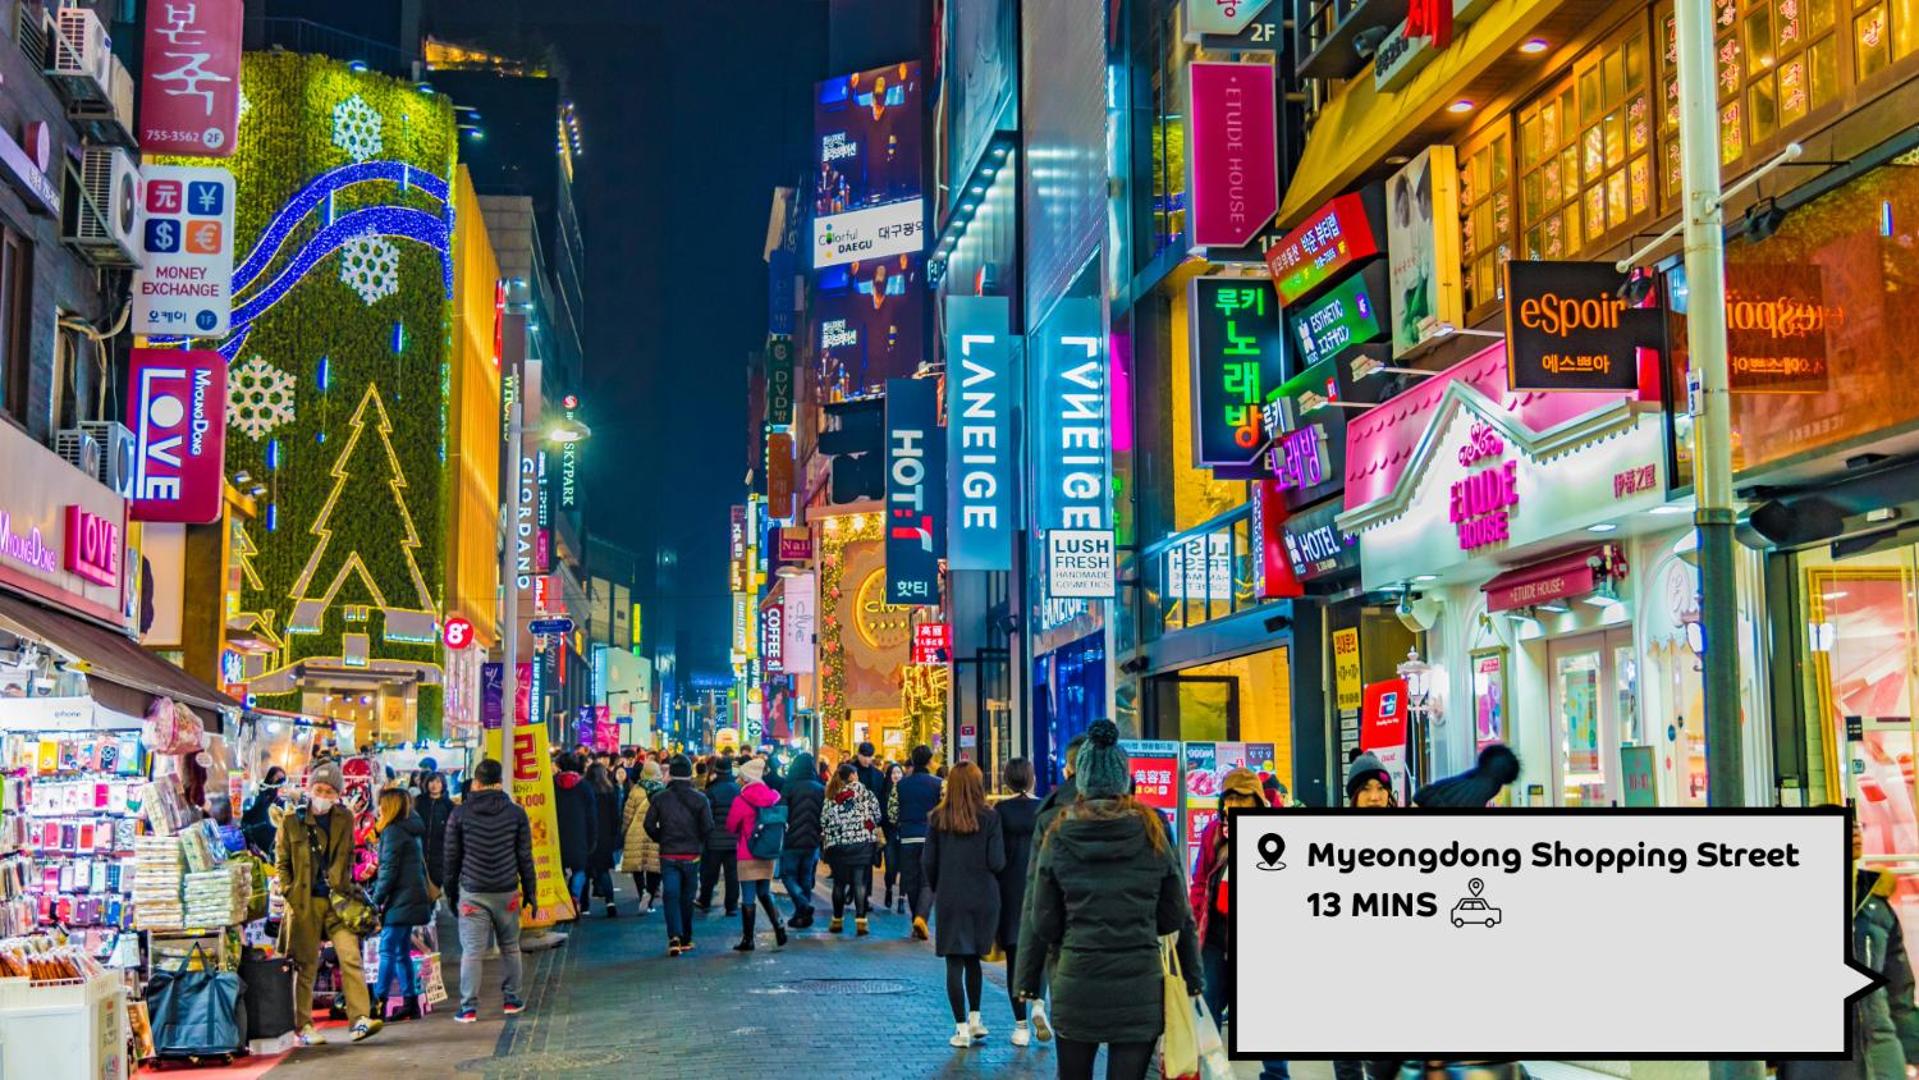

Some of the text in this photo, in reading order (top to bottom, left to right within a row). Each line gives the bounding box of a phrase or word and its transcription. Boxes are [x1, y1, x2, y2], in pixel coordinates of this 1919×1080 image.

[1250, 23, 1276, 42] 2F
[153, 2, 231, 116] 본죽
[146, 128, 221, 146] 755-3562 2F
[1226, 88, 1245, 224] ETUDE HOUSE
[838, 240, 873, 253] DAEGU
[156, 266, 207, 280] MONEY
[142, 281, 219, 297] EXCHANGE
[1215, 288, 1264, 316] 루키
[147, 309, 186, 324] 오케이
[1310, 299, 1343, 333] ESTHETIC
[1542, 354, 1610, 374] 에스쁘아
[138, 368, 186, 500] LOVE
[563, 442, 575, 506] SKYPARK
[517, 457, 535, 589] GIORDANO
[1459, 511, 1510, 551] HOUSE
[65, 505, 118, 588] LOVE
[783, 542, 811, 551] Nail
[1055, 539, 1109, 554] LUSH
[1299, 525, 1341, 562] HOTEL
[1055, 556, 1110, 569] FRESH
[1056, 570, 1110, 580] HANDMADE
[897, 580, 928, 596] 핫티
[1513, 578, 1562, 602] ETUDE HOUSE
[768, 608, 780, 658] COFFEE
[1135, 769, 1171, 785] 美容室
